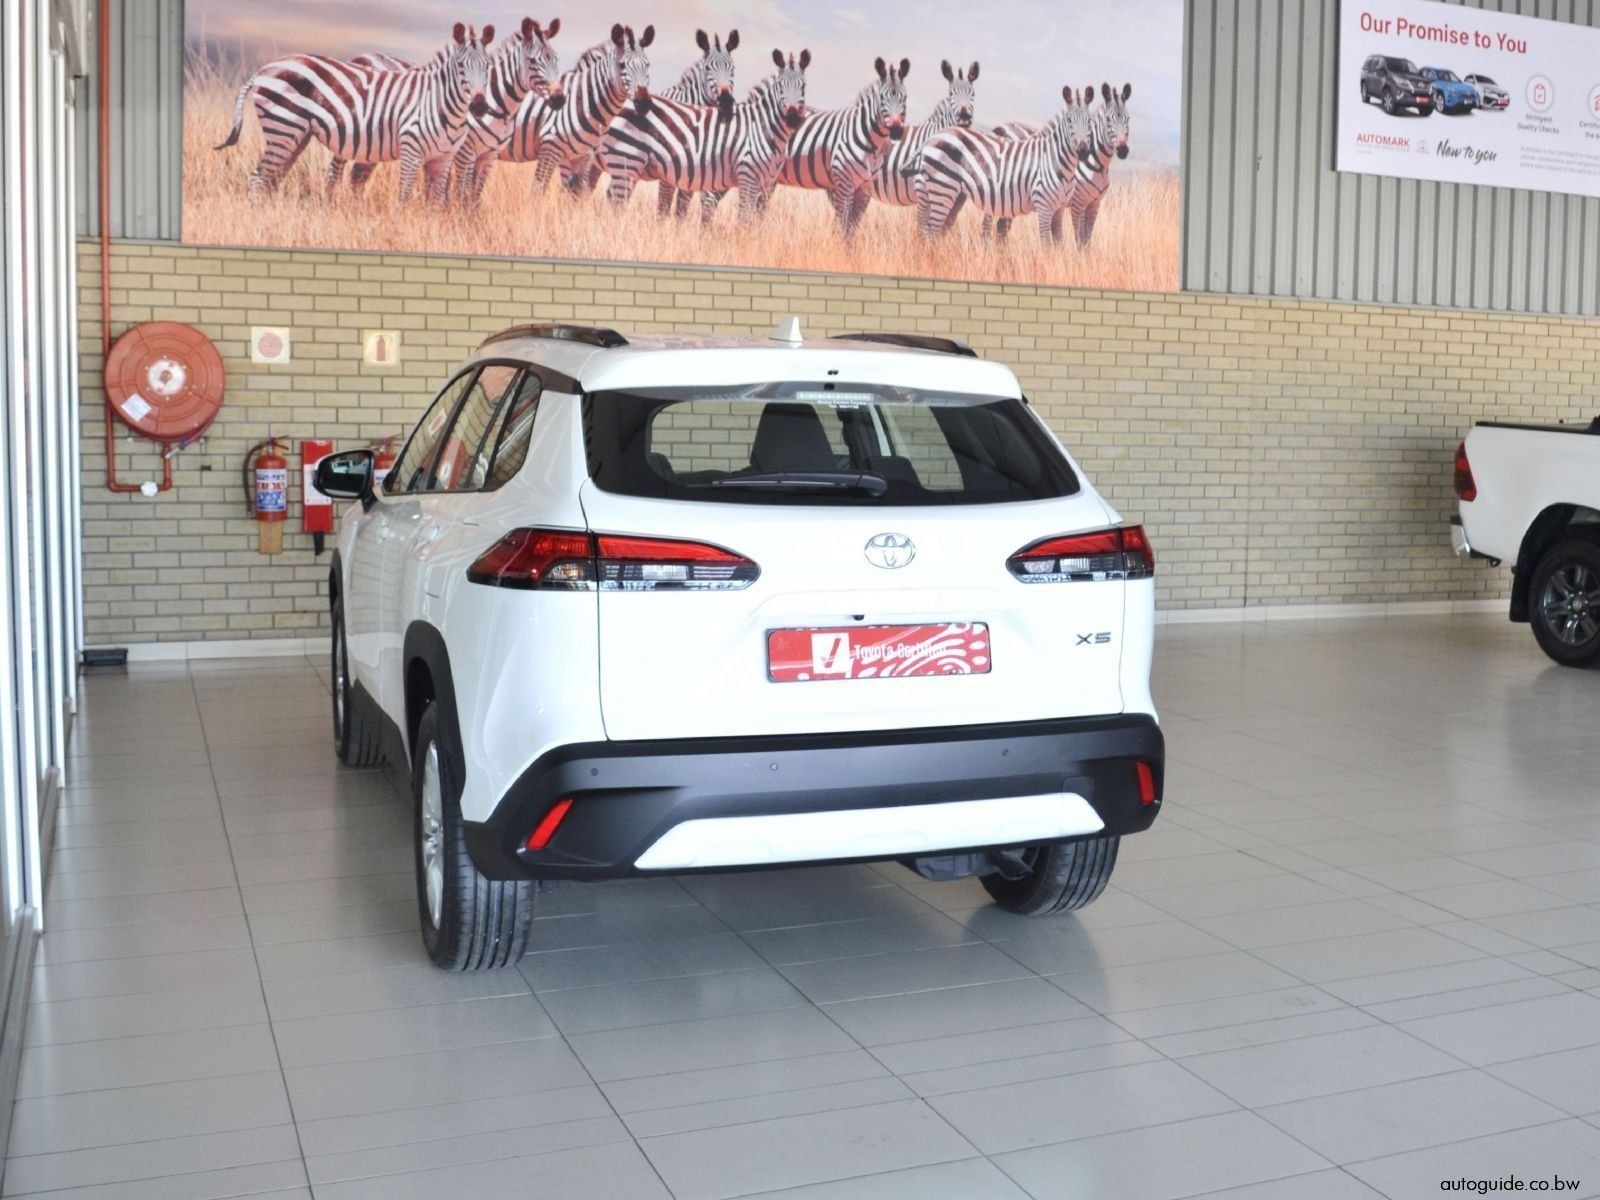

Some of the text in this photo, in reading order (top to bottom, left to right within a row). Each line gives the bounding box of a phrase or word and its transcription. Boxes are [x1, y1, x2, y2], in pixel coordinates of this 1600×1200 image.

[1360, 12, 1527, 54] Our Promise to You
[1356, 133, 1410, 148] AUTOMARK
[1464, 145, 1474, 159] to
[1474, 148, 1497, 165] you
[854, 643, 893, 660] Toyota
